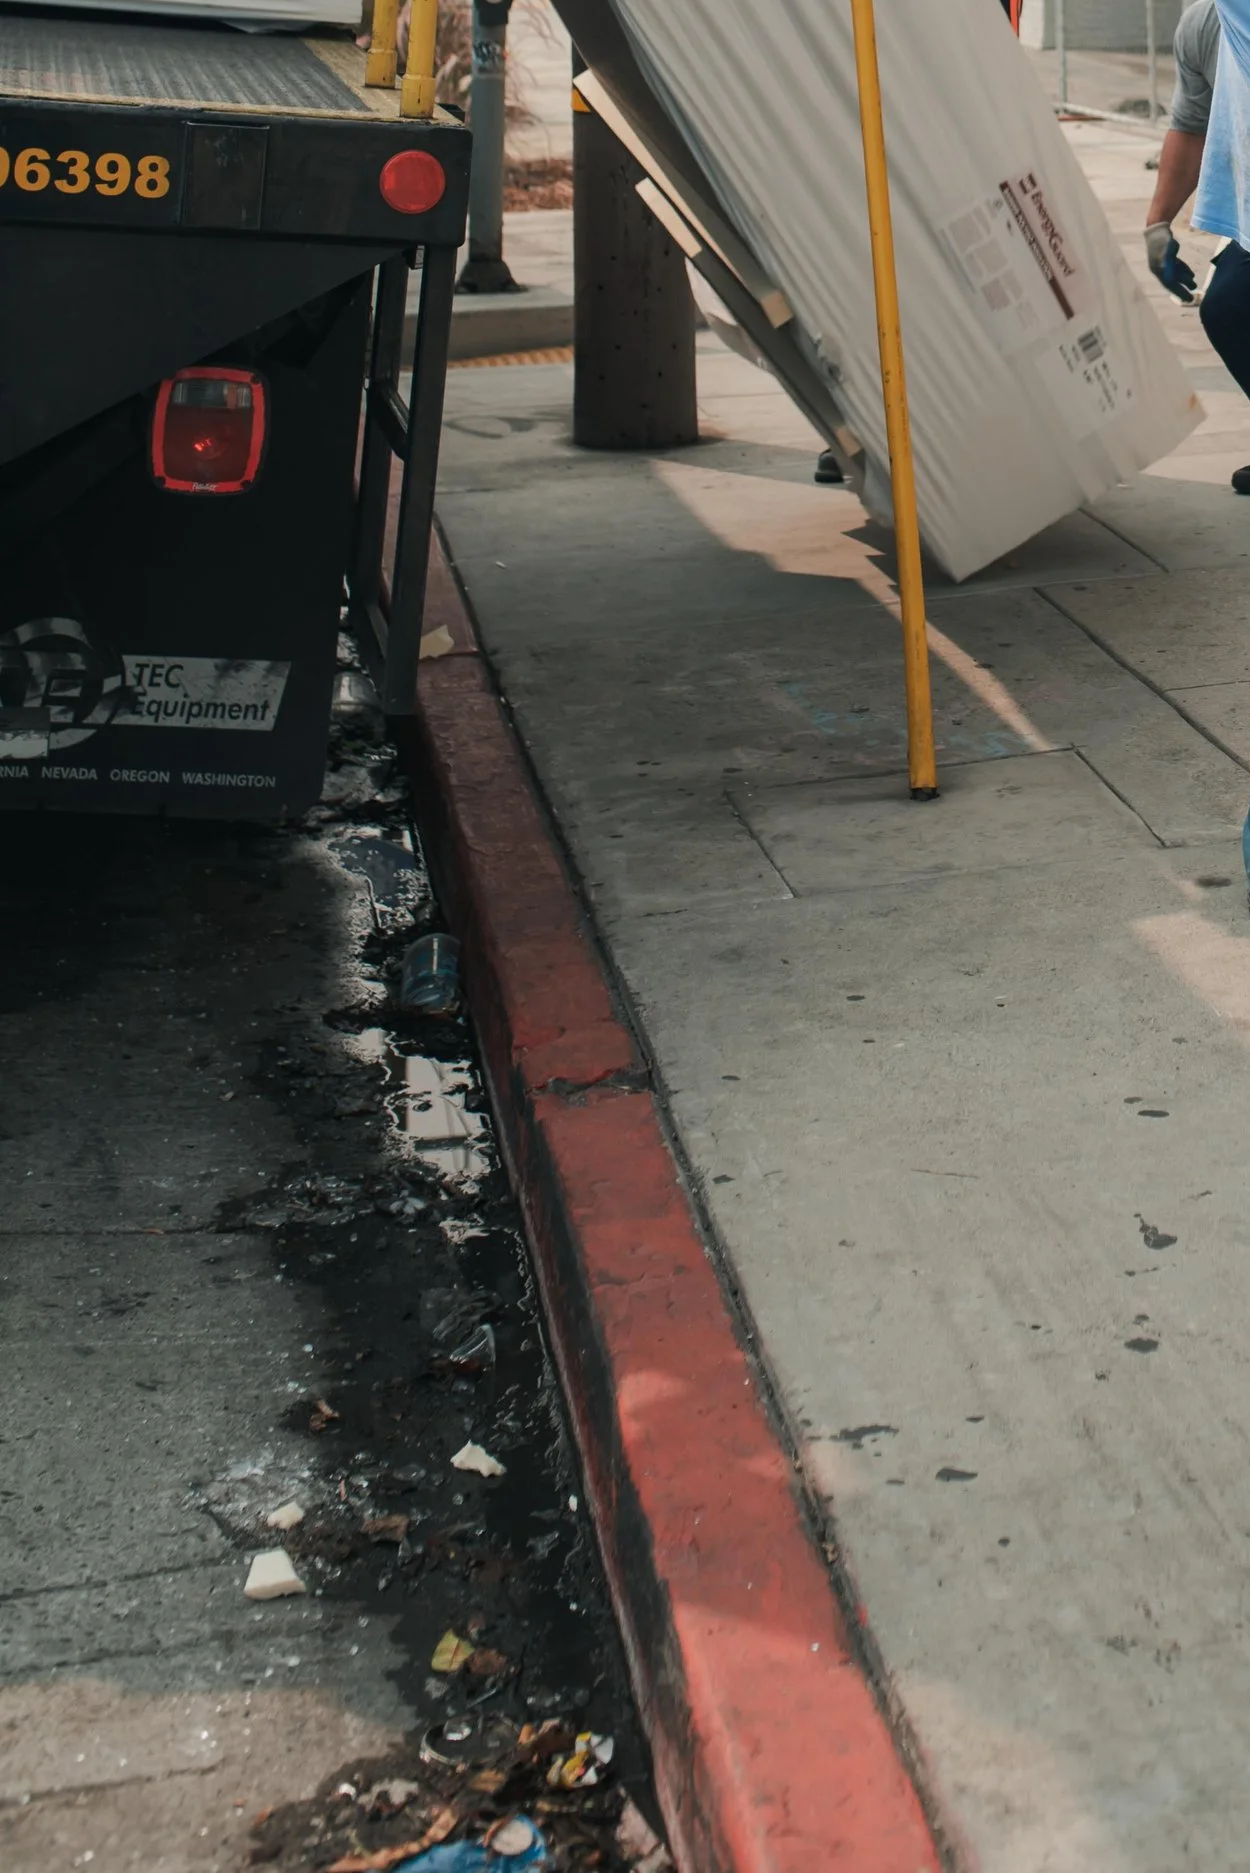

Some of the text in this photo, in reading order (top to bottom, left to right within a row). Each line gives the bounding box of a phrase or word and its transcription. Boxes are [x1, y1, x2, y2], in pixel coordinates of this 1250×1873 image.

[1031, 190, 1075, 277] EnergyGuard
[133, 663, 184, 688] TEC
[131, 691, 270, 724] Equipment
[41, 766, 98, 780] NEVADA
[110, 769, 170, 783] OREGON
[182, 772, 276, 788] WASHINGTON
